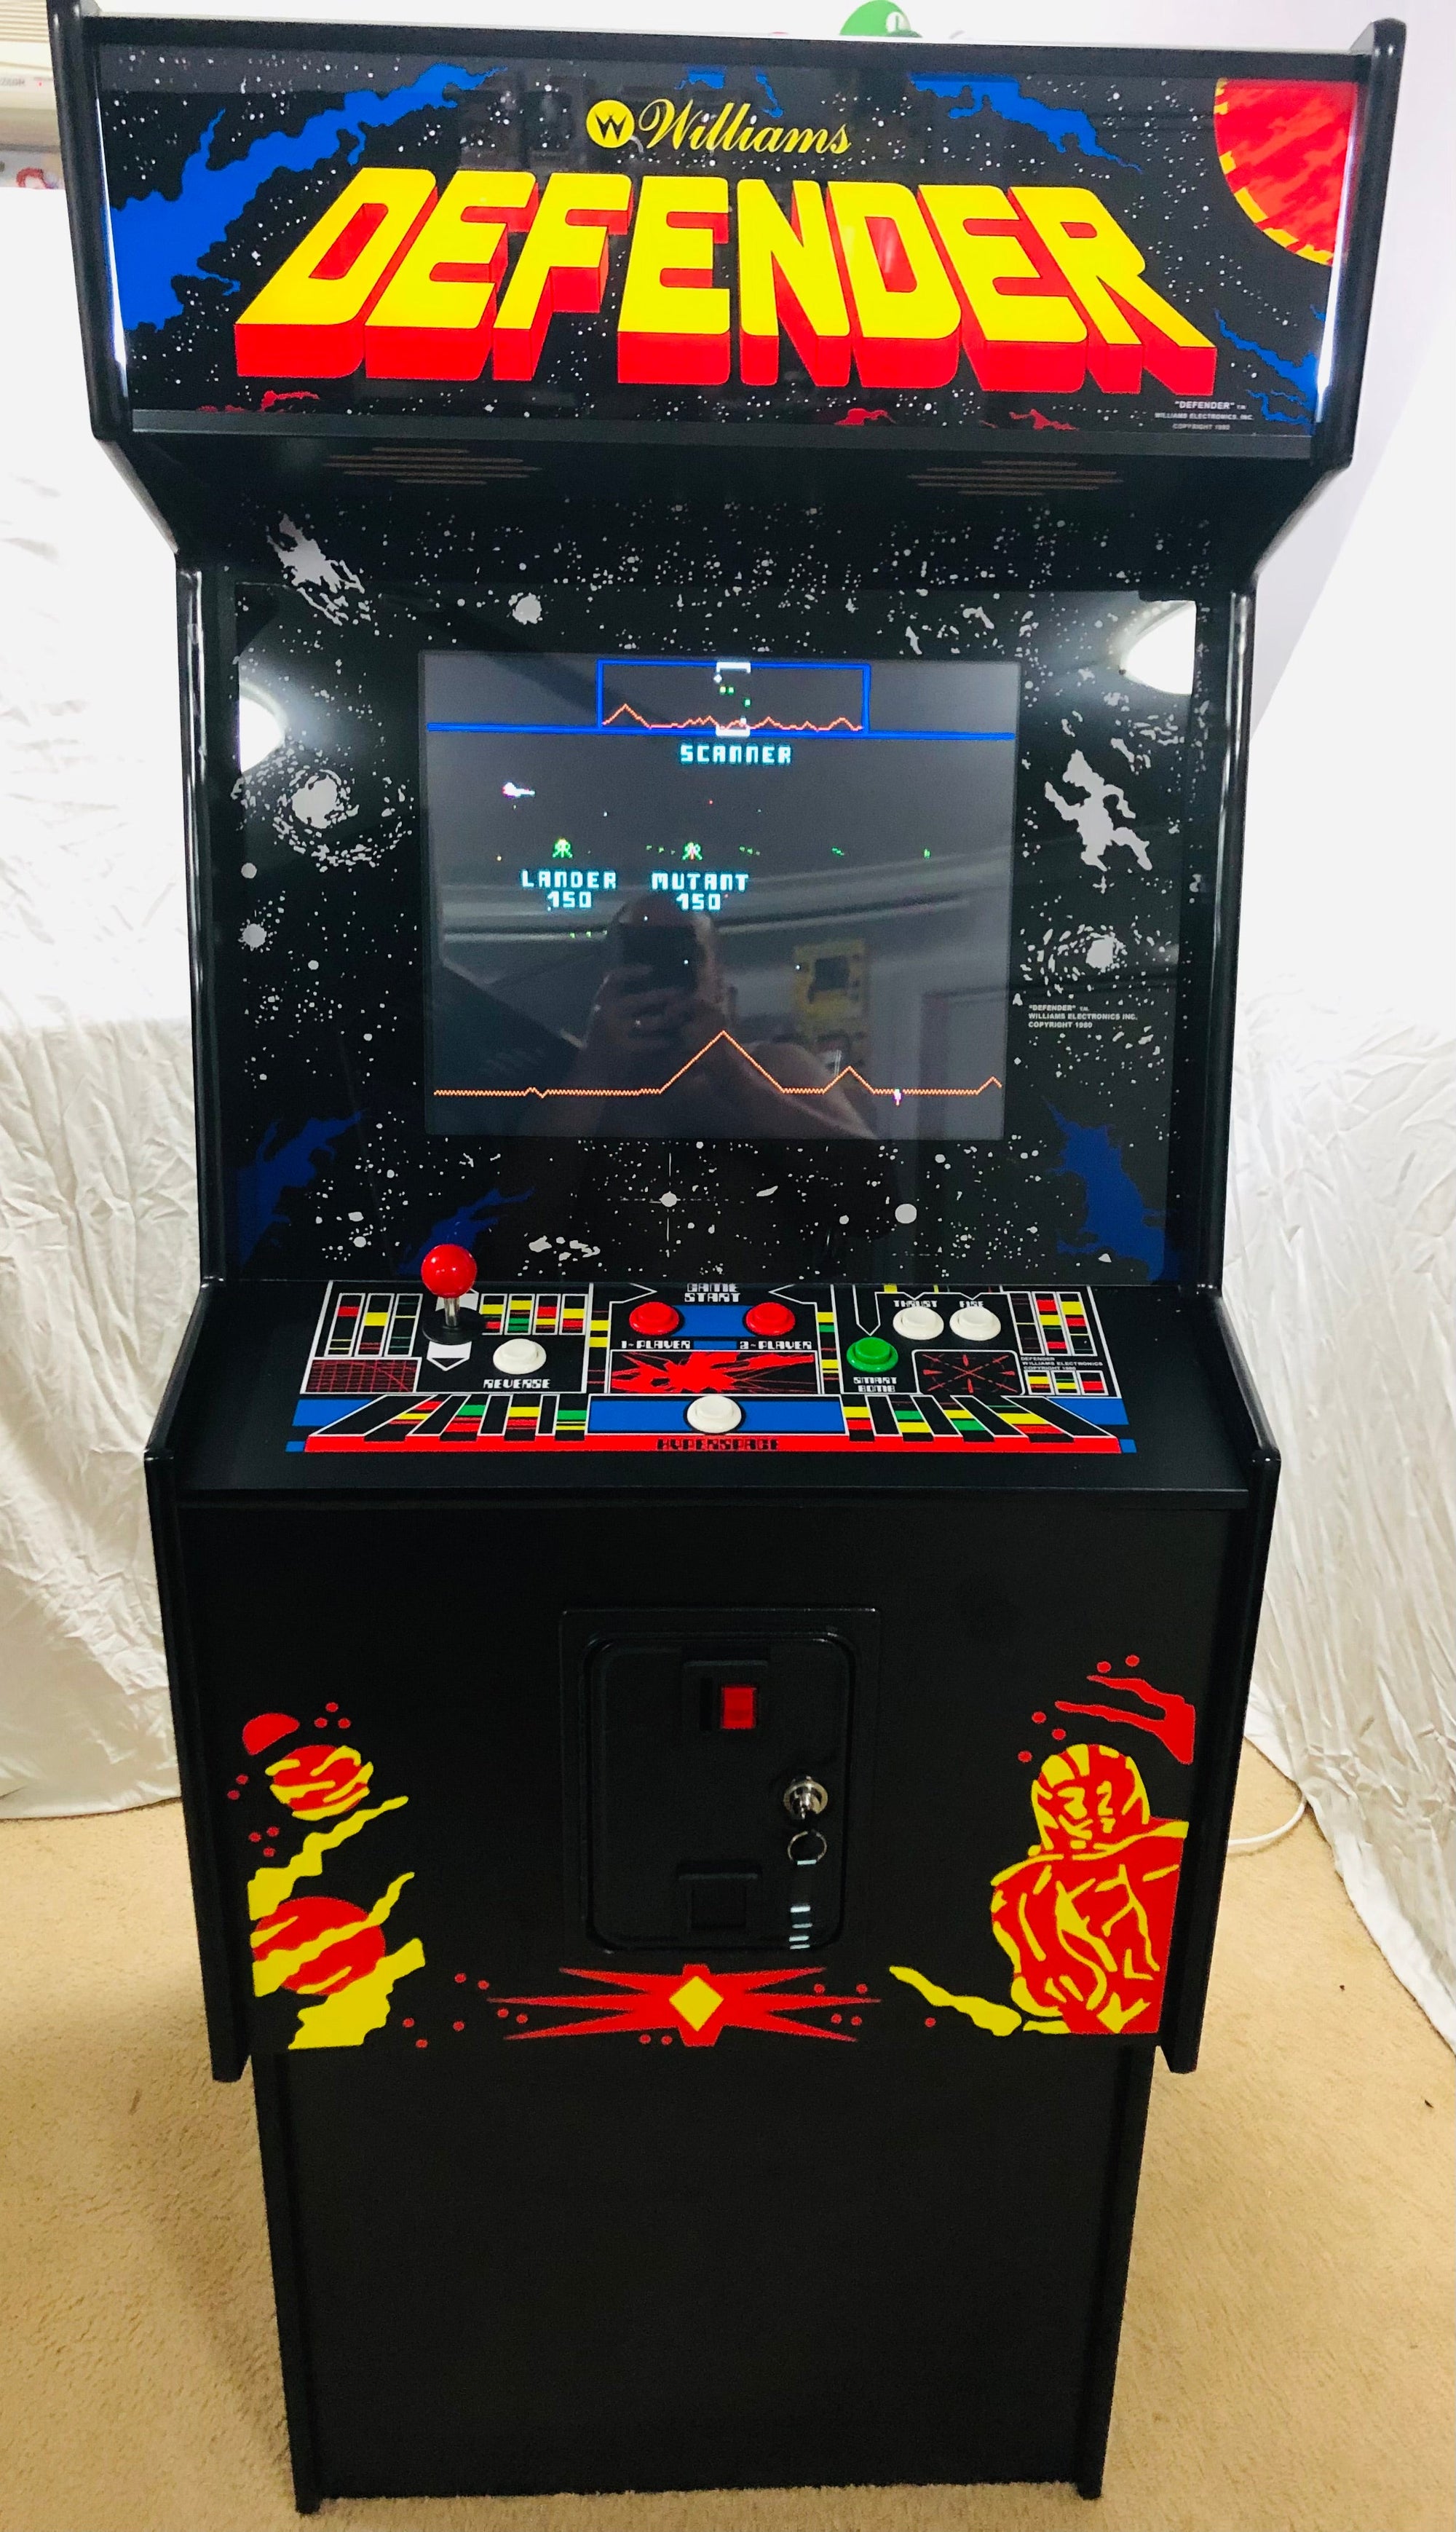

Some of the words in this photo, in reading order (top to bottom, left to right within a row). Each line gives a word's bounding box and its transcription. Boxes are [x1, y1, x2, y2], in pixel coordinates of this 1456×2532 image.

[638, 98, 852, 154] Williams
[234, 167, 1217, 398] DEFENDER
[1172, 422, 1213, 430] COPYRIGHT
[680, 744, 792, 765] SCANNER
[521, 869, 617, 890] LANDER
[652, 871, 749, 892] MUTANT
[547, 891, 592, 909] 150
[676, 892, 721, 911] 150
[1028, 1012, 1066, 1020] WILLIAMS
[1067, 1012, 1120, 1021] ELECTRONICS
[1075, 1021, 1093, 1029] 1980
[687, 1282, 739, 1293] GAME
[684, 1293, 741, 1303] START
[893, 1300, 938, 1308] THRUST
[483, 1379, 551, 1389] REVERSE
[852, 1376, 897, 1384] SMART
[858, 1384, 896, 1392] BOMB
[657, 1437, 778, 1451] HYPERSPACE
